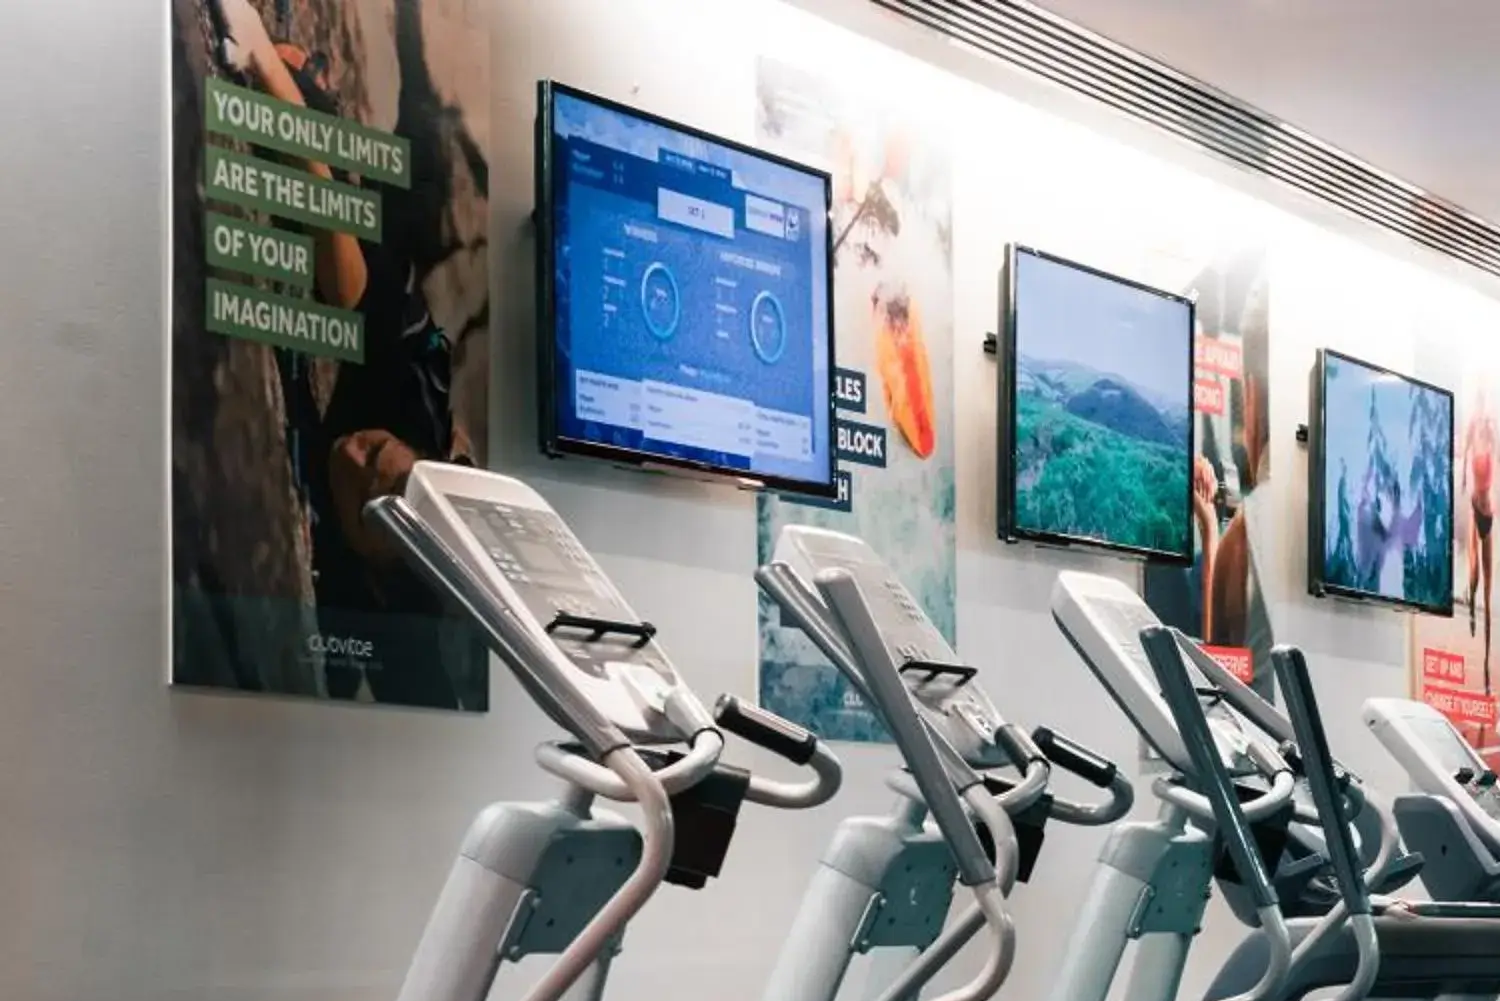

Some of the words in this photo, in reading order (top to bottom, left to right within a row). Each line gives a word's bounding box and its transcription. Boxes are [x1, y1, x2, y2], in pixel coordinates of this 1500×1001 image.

[213, 91, 275, 138] YOUR
[278, 112, 332, 151] ONLY
[337, 130, 404, 175] LIMITS
[213, 158, 257, 196] ARE
[261, 173, 305, 210] THE
[309, 183, 376, 228] LIMITS
[213, 225, 244, 256] OF
[248, 234, 308, 275] YOUR
[213, 291, 359, 351] IMAGINATION
[835, 375, 862, 402] LES
[837, 427, 883, 458] BLOCK
